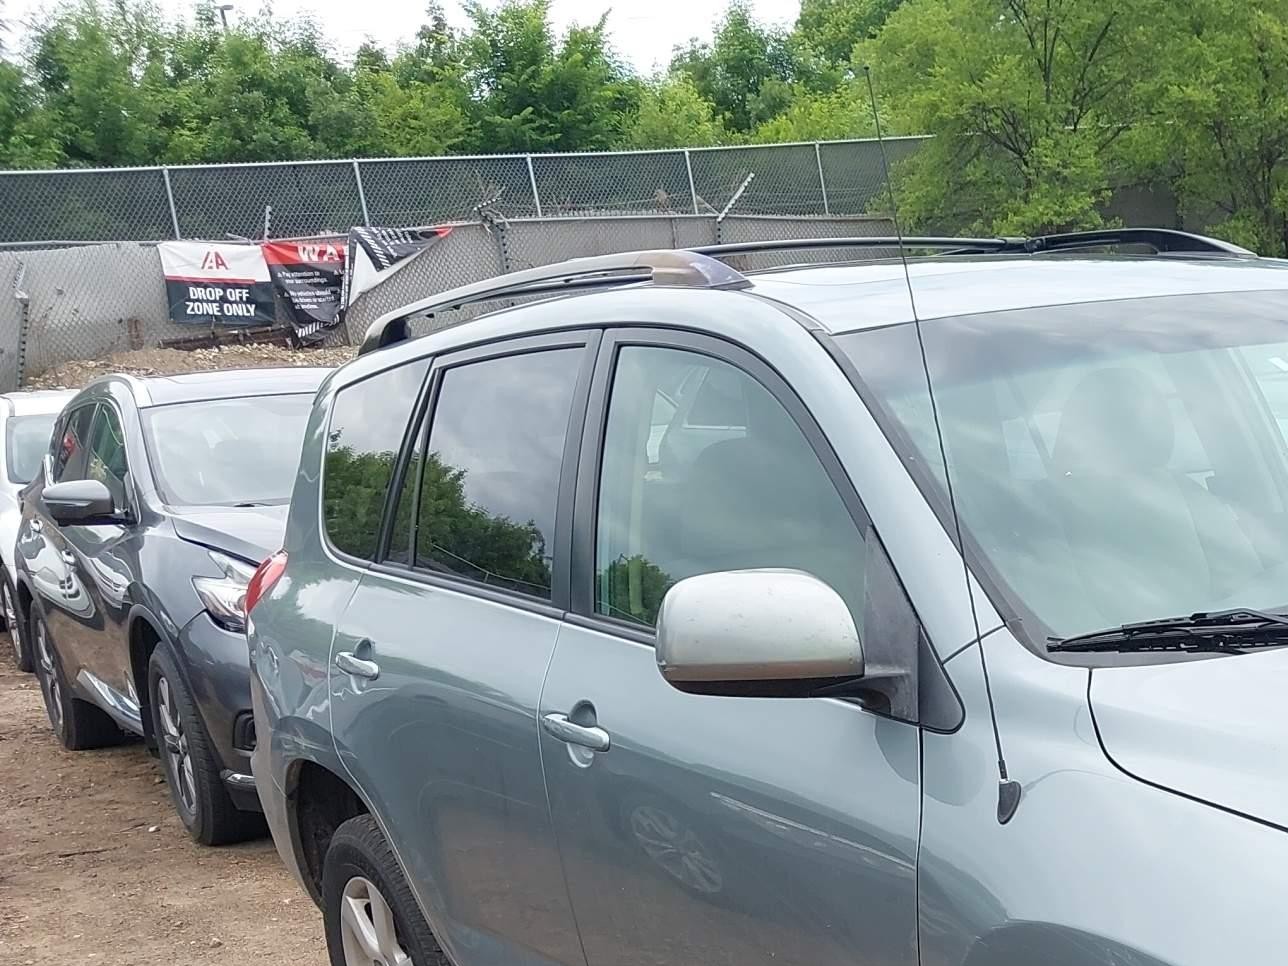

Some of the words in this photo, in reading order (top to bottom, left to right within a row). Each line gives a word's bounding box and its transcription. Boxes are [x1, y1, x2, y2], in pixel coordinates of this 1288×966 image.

[189, 287, 224, 301] DROP
[226, 288, 250, 301] OFF
[186, 302, 221, 316] ZONE
[223, 303, 256, 318] ONLY
